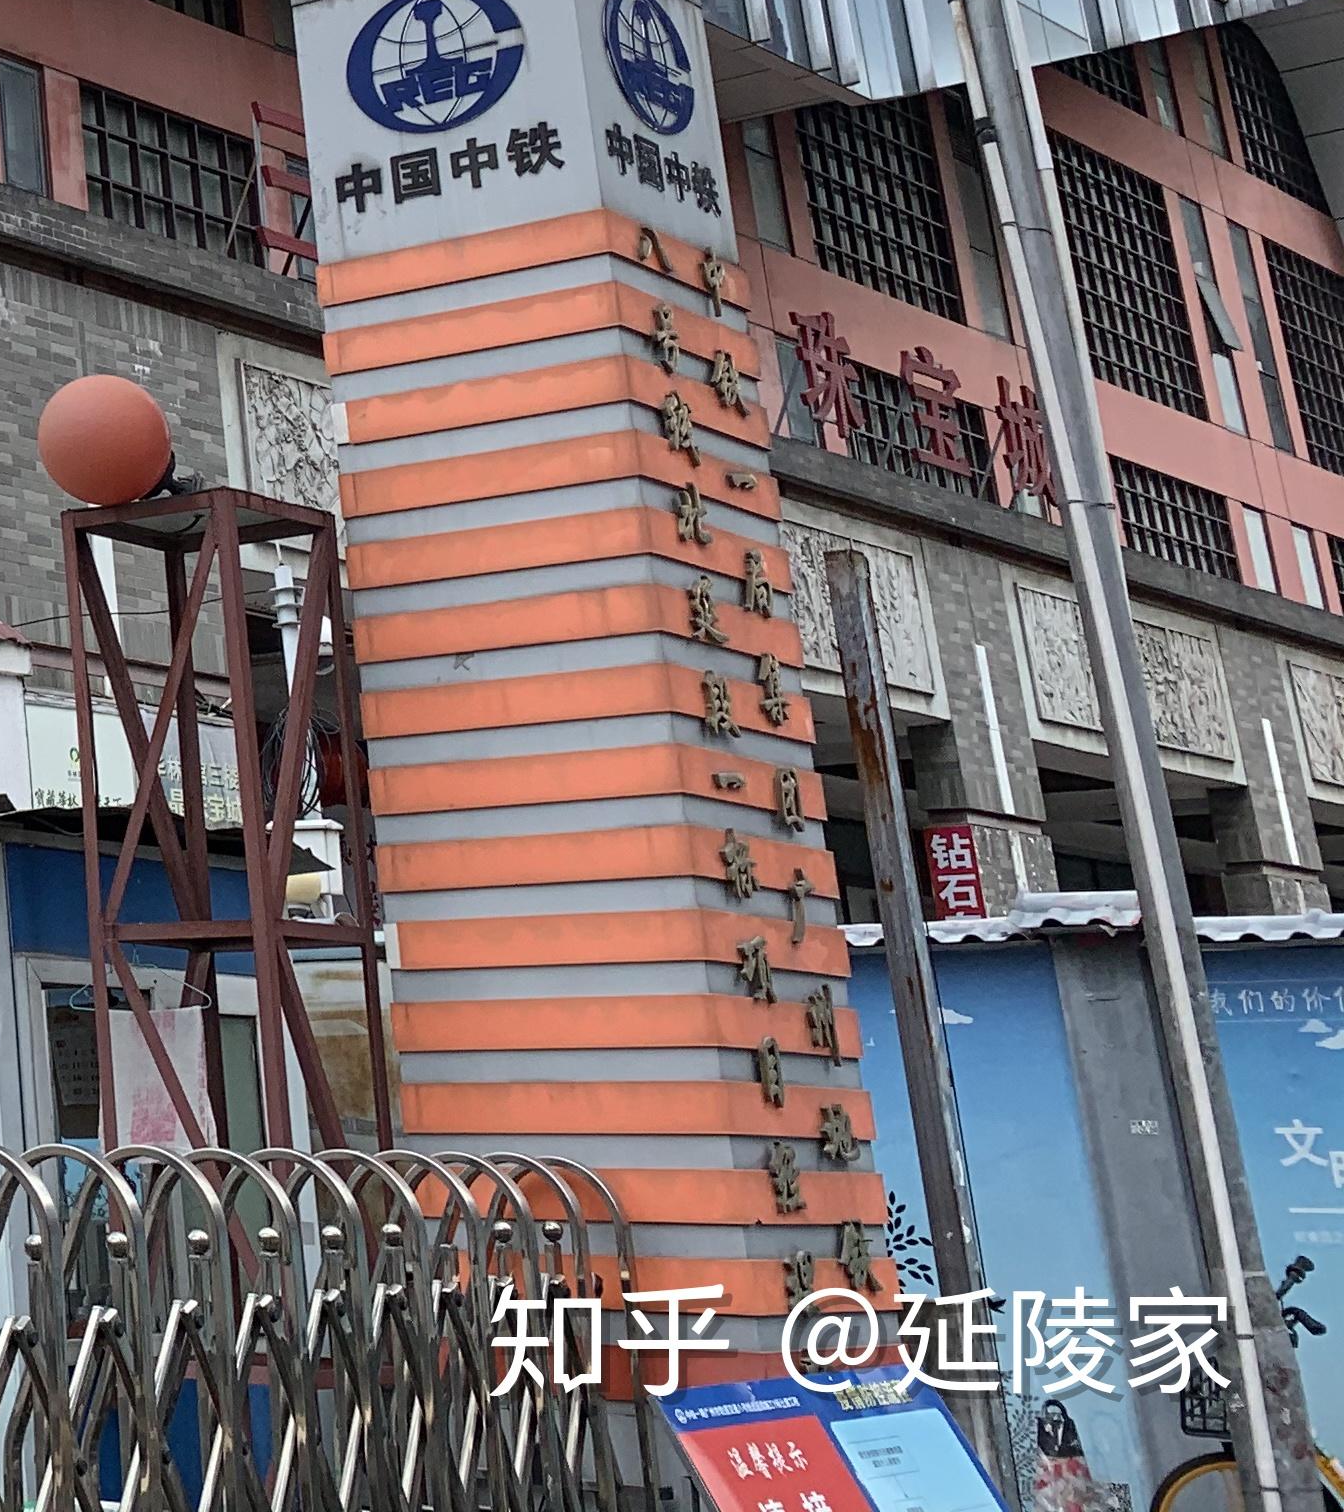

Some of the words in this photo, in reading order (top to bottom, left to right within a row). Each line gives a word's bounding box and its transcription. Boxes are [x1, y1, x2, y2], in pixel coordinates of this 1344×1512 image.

[334, 121, 566, 214] 中国中铁
[605, 123, 722, 218] 中国中铁
[789, 310, 1062, 510] 珠宝城
[930, 835, 981, 918] 钻石
[727, 1441, 809, 1480] 温馨提示
